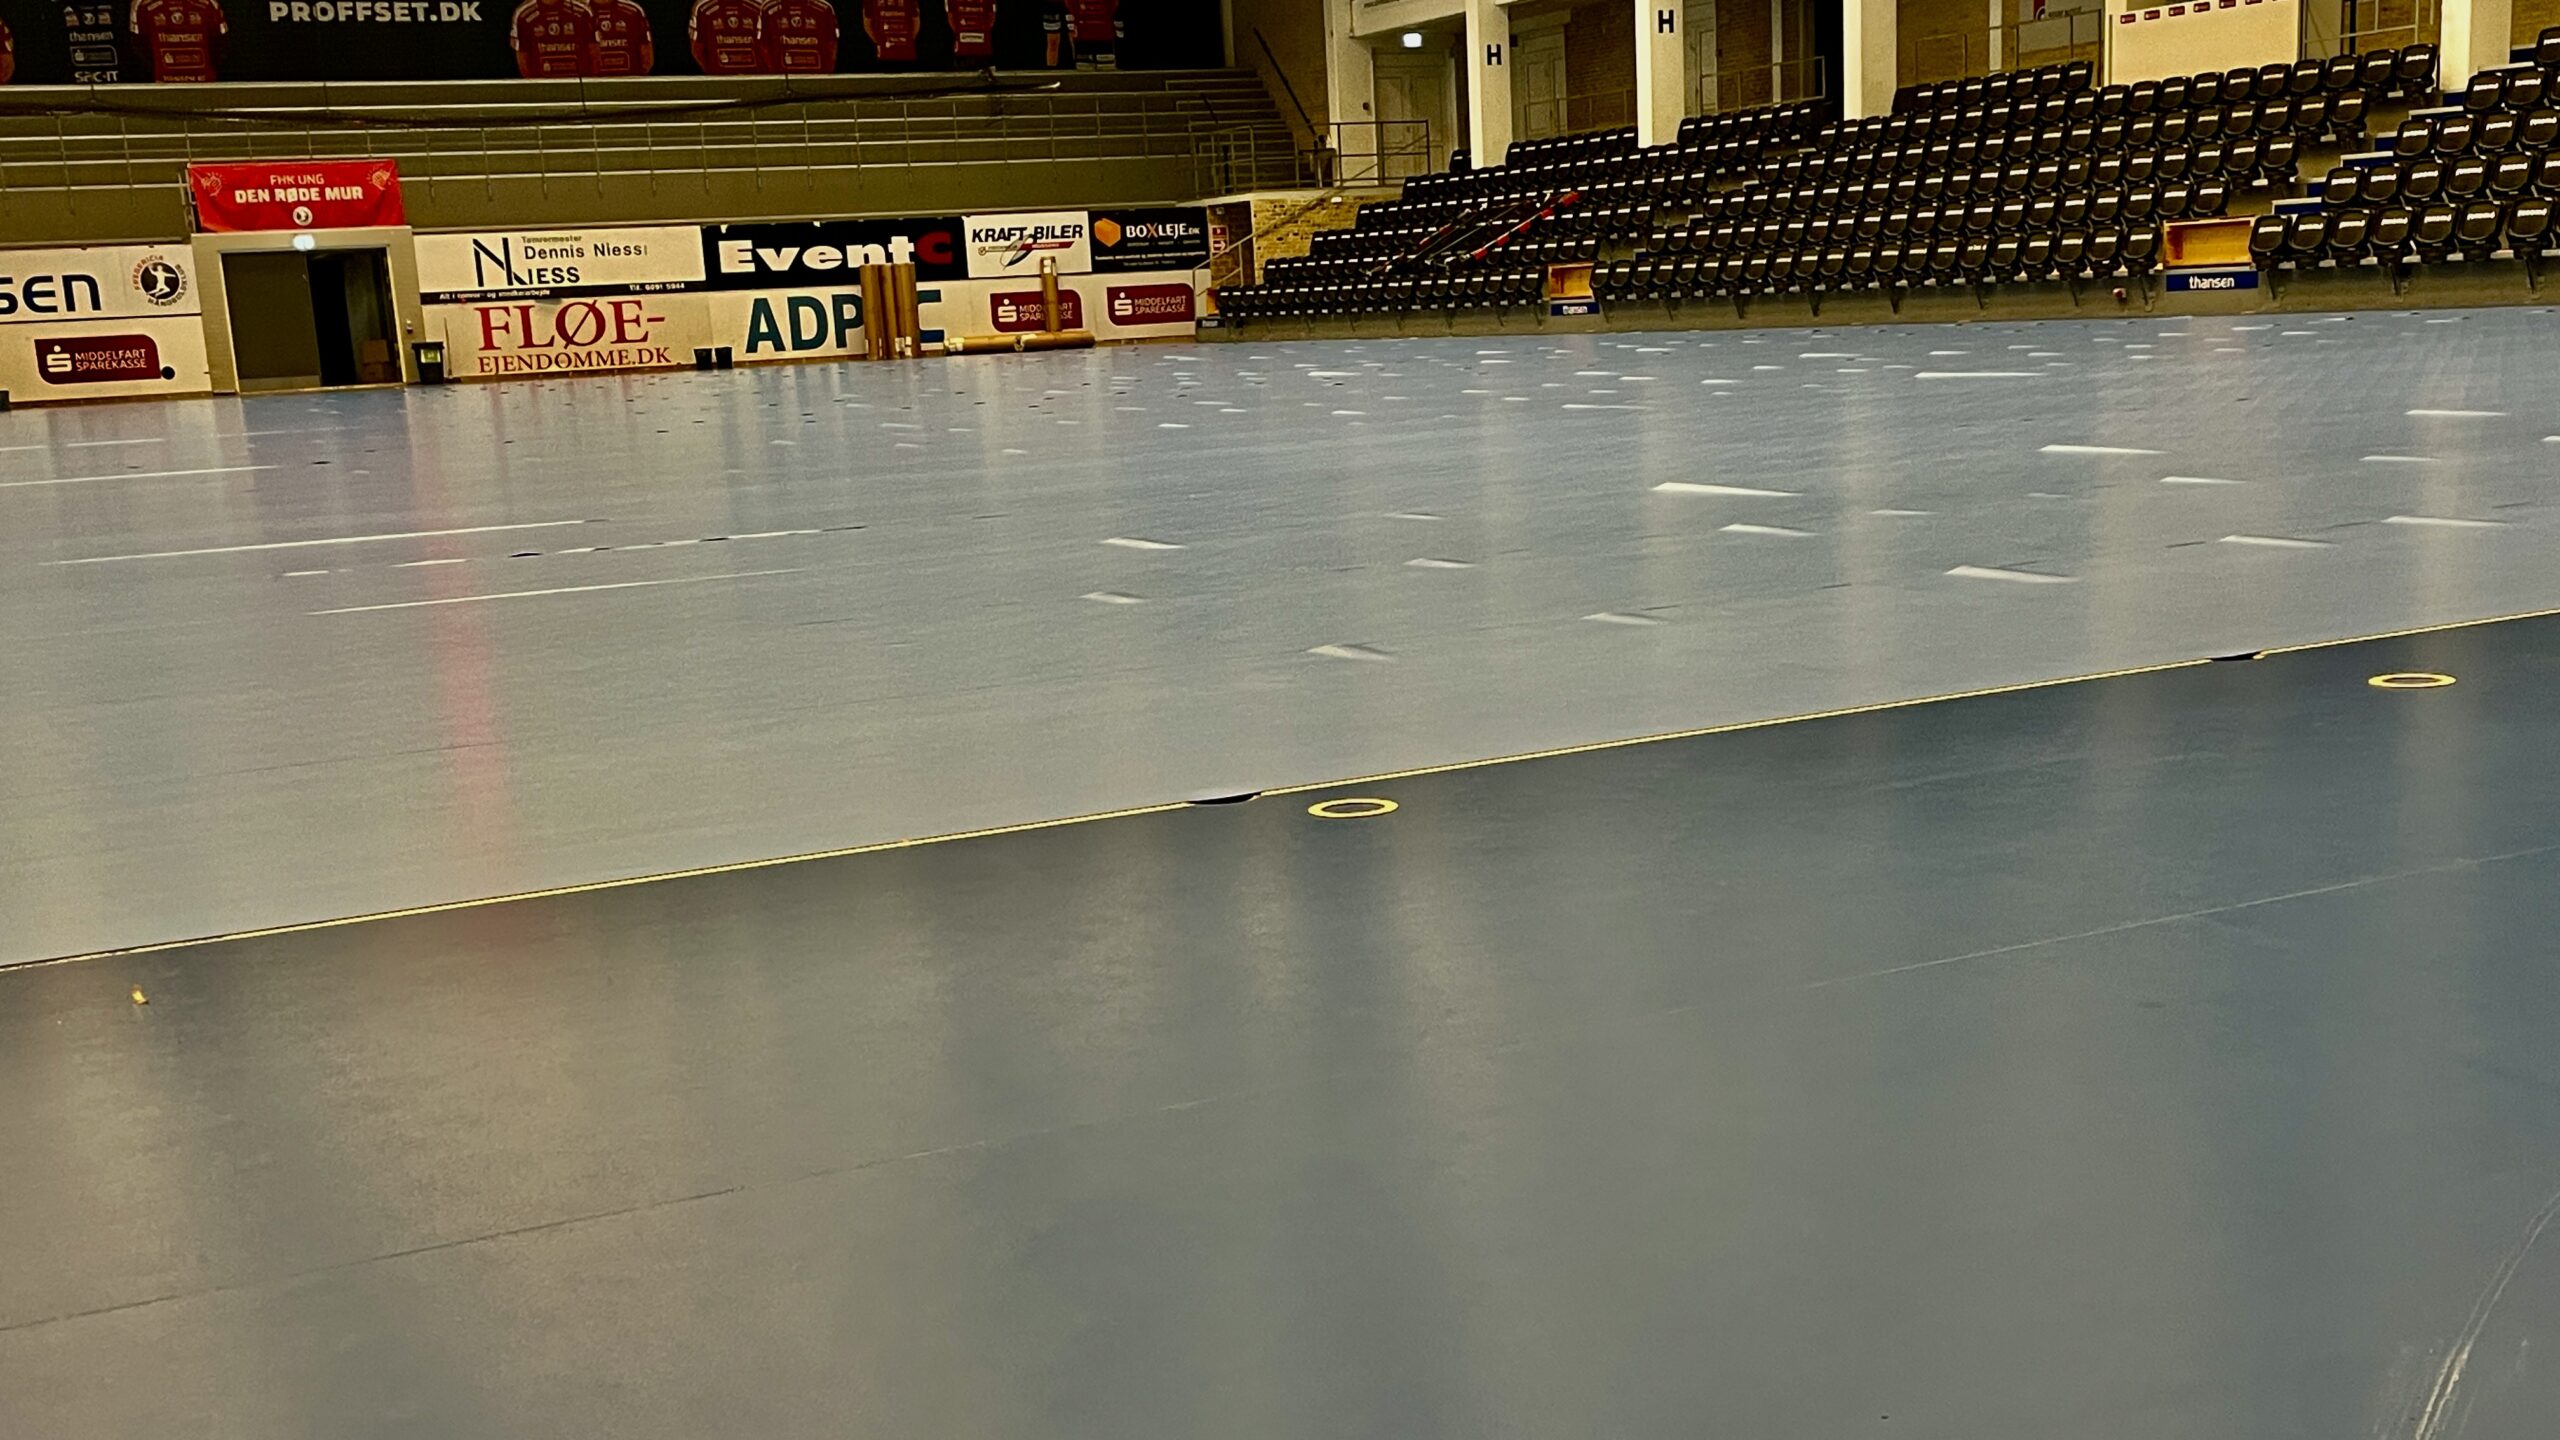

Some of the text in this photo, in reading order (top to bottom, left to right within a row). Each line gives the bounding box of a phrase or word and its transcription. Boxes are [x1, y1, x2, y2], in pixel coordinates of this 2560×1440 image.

[269, 1, 482, 22] PROFFSET.DK
[1658, 9, 1674, 34] H
[1486, 44, 1502, 66] H
[270, 173, 325, 186] FHK UNG
[234, 185, 363, 204] DEN RØDE MUR
[971, 224, 1084, 243] KRAFT BILER
[524, 244, 585, 260] Dennis
[2188, 275, 2235, 289] thansen
[474, 295, 666, 351] FLØE-
[75, 349, 146, 361] MIDDELFART
[478, 347, 672, 374] EJENDOMME.DK
[75, 359, 148, 372] SPAREKASSE
